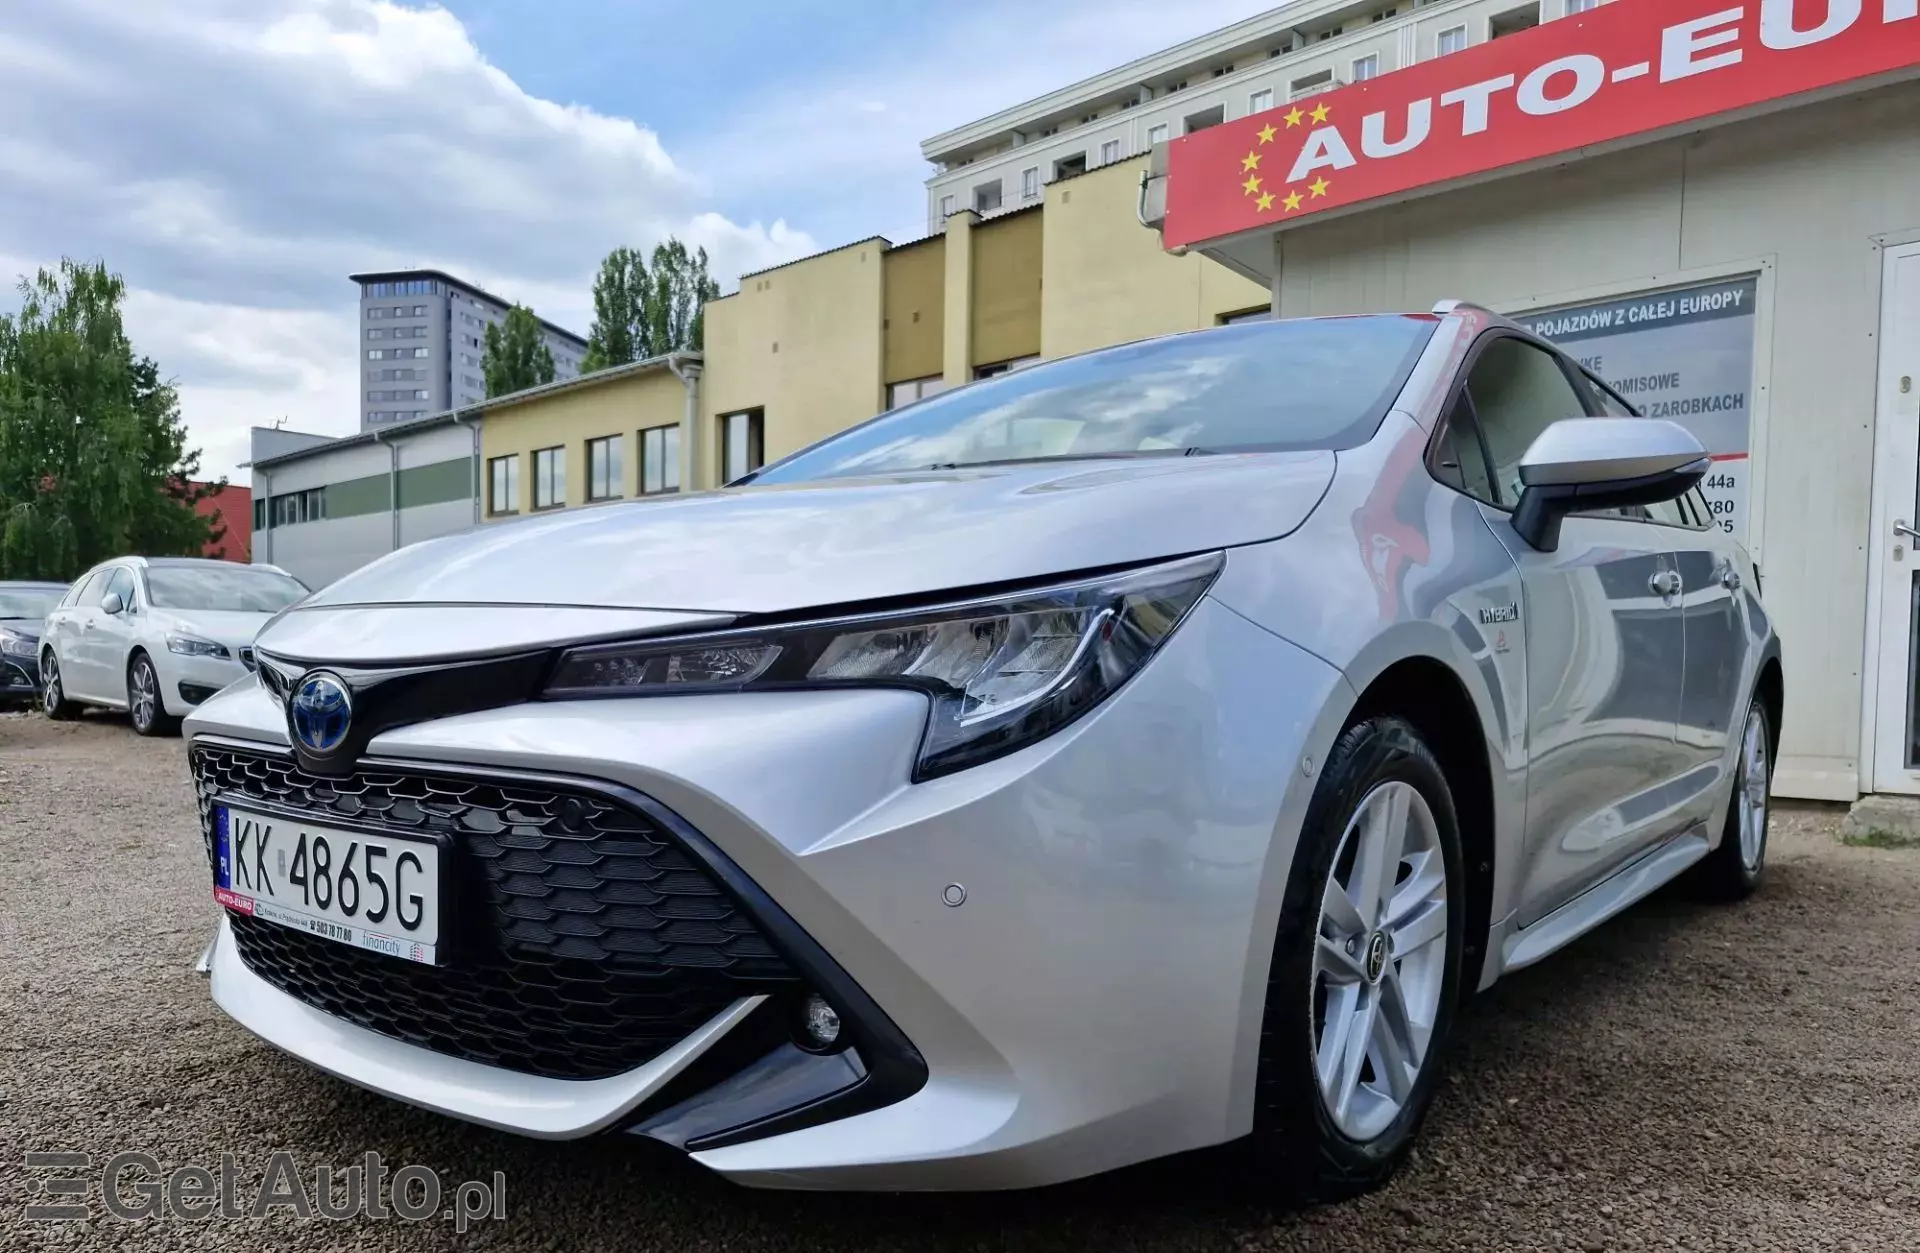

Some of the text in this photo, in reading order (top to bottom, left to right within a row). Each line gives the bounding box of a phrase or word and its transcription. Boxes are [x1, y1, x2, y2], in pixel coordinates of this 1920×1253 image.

[1536, 289, 1743, 337] POJAZDÓW Z CAŁEJ EUROPY
[1608, 372, 1680, 395] OMISOWE
[1651, 393, 1744, 418] ZAROBKACH
[1706, 473, 1735, 489] 44a
[235, 816, 424, 931] KK 4865G
[218, 892, 253, 911] AUTO-EURO
